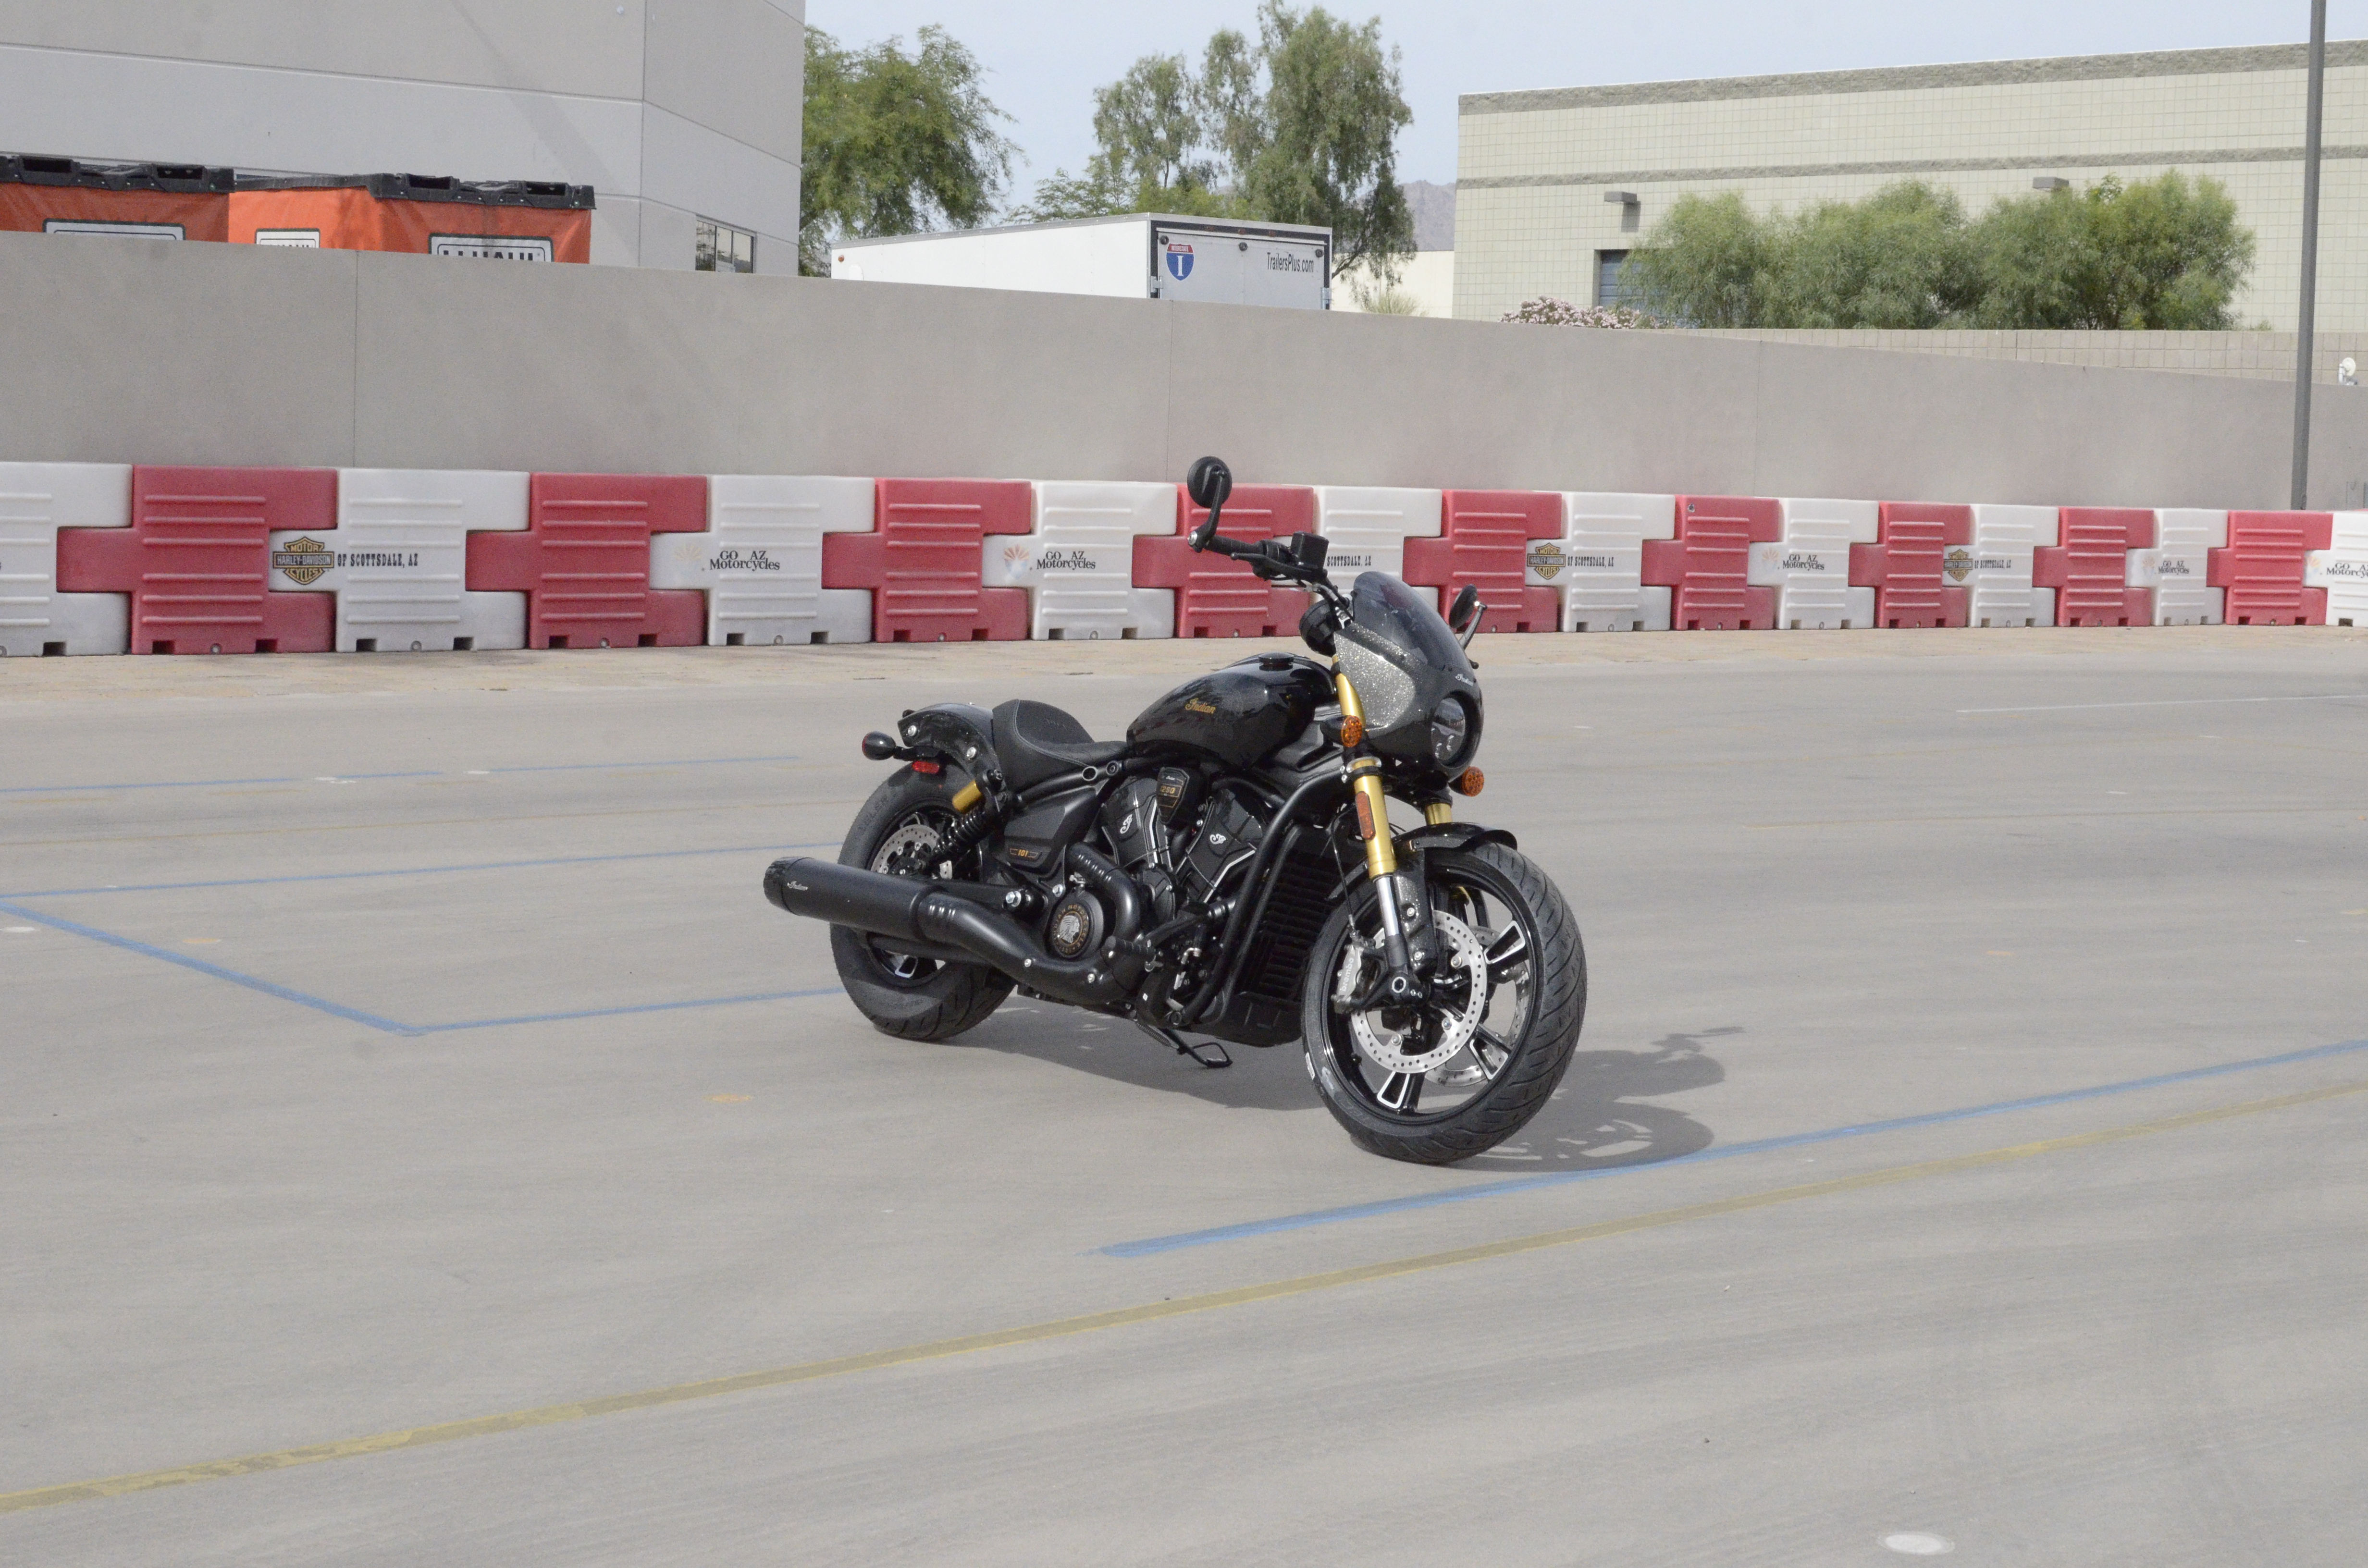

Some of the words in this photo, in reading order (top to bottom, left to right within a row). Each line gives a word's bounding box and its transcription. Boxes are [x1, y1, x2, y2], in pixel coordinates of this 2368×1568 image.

[1267, 252, 1314, 272] TrailersPlus.com
[290, 541, 319, 552] MOTOR
[277, 555, 332, 565] HARLEY-DAVIDSON
[337, 553, 346, 567] OF
[350, 553, 405, 568] SCOTTSDALE,
[408, 553, 418, 567] AZ
[719, 551, 739, 560] GO
[750, 551, 766, 560] AZ
[1046, 551, 1061, 561] GO
[1071, 551, 1084, 560] AZ
[710, 558, 780, 572] Motorcycles
[1036, 558, 1096, 571] Motorcycles
[1567, 556, 1573, 567] OF
[1575, 556, 1606, 568] SCOTTSDALE,
[1783, 560, 1825, 571] Motorcycles
[2158, 566, 2190, 575] Motorcycles
[1184, 698, 1216, 714] Indian
[1018, 849, 1028, 857] 101
[1339, 957, 1354, 992] brembo
